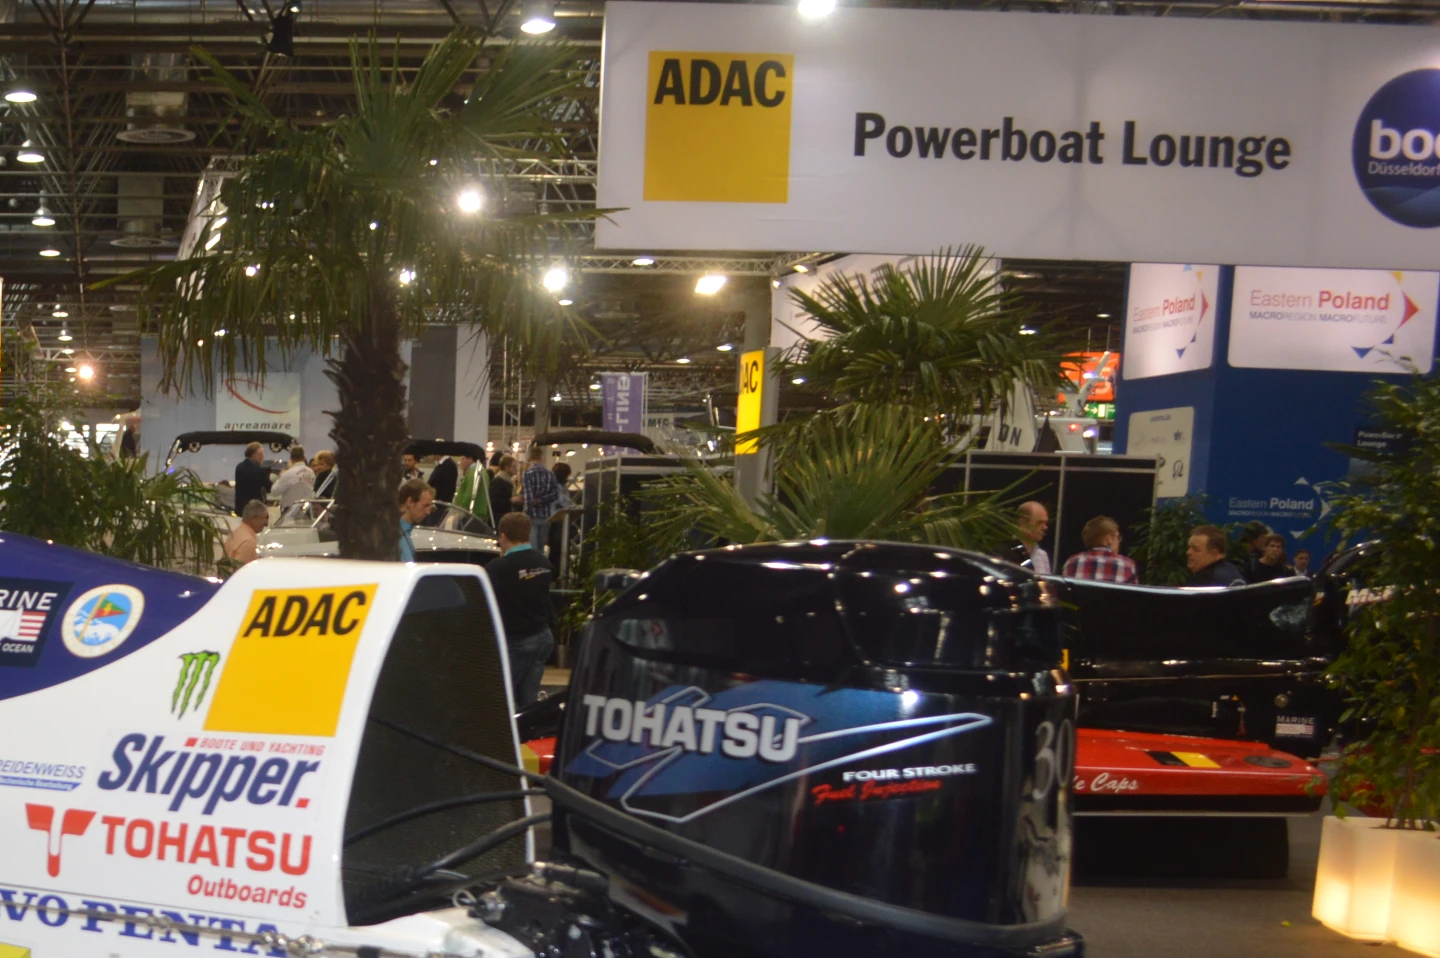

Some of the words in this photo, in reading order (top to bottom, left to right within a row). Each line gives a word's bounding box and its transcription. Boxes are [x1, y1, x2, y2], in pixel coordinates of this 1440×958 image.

[654, 58, 786, 108] ADAC
[854, 112, 1105, 166] Powerboat
[1123, 120, 1291, 178] Lounge
[1369, 118, 1440, 161] bo
[1162, 294, 1195, 316] Poland
[1250, 290, 1313, 308] Eastern
[1318, 290, 1390, 310] Poland
[1249, 311, 1317, 321] MACROREGION
[1228, 497, 1268, 509] Eastern
[1269, 497, 1314, 510] Poland
[242, 590, 367, 637] ADAC
[2, 642, 34, 653] OCEAN
[584, 694, 800, 763] TOHATSU
[1276, 715, 1315, 724] MARINE
[200, 738, 239, 750] BOOTE
[240, 740, 265, 752] UND
[268, 742, 326, 756] YACHTING
[842, 768, 900, 782] FOUR
[902, 763, 976, 779] STROKE
[1090, 772, 1139, 793] Caps
[101, 816, 313, 876] TOHATSU
[187, 875, 308, 909] Outboards
[80, 900, 291, 958] PENTA
